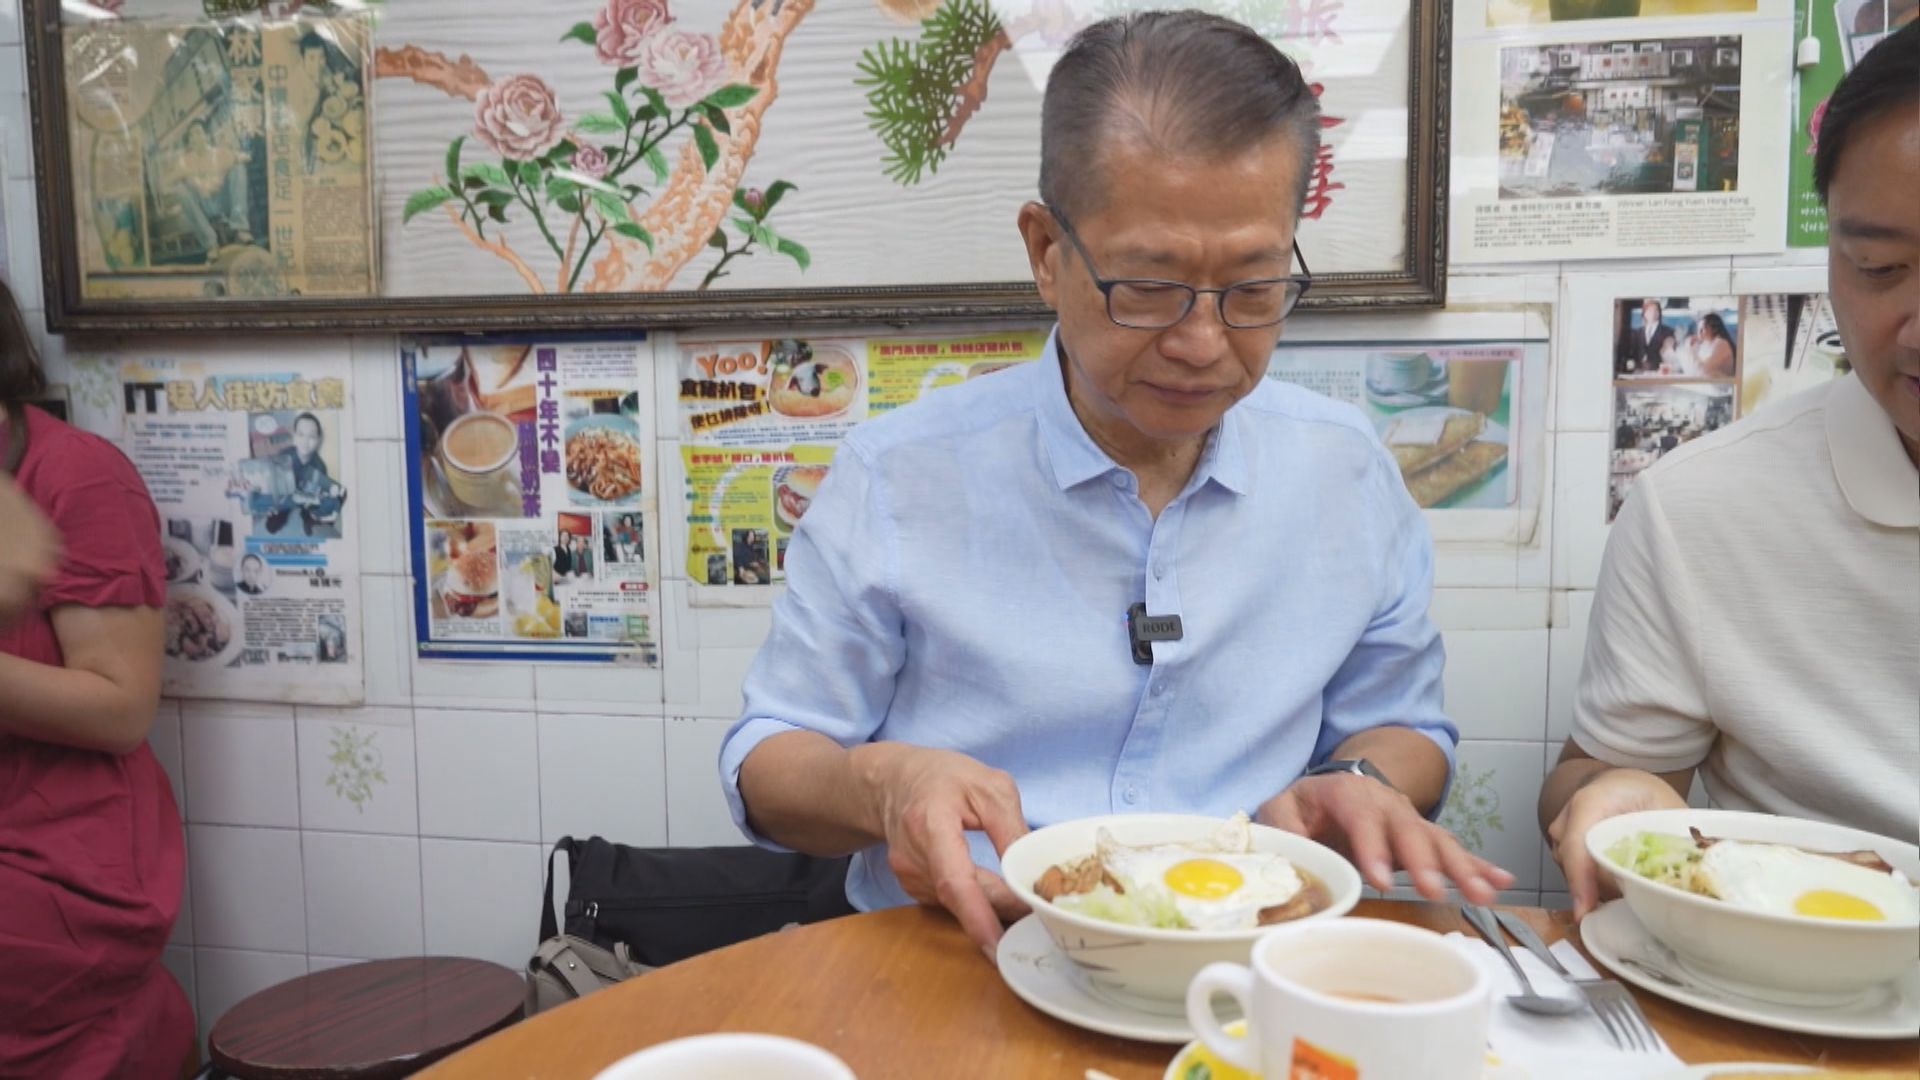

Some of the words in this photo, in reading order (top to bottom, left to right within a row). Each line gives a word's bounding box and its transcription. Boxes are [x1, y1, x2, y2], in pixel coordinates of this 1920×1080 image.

[537, 347, 561, 474] 四十年不變
